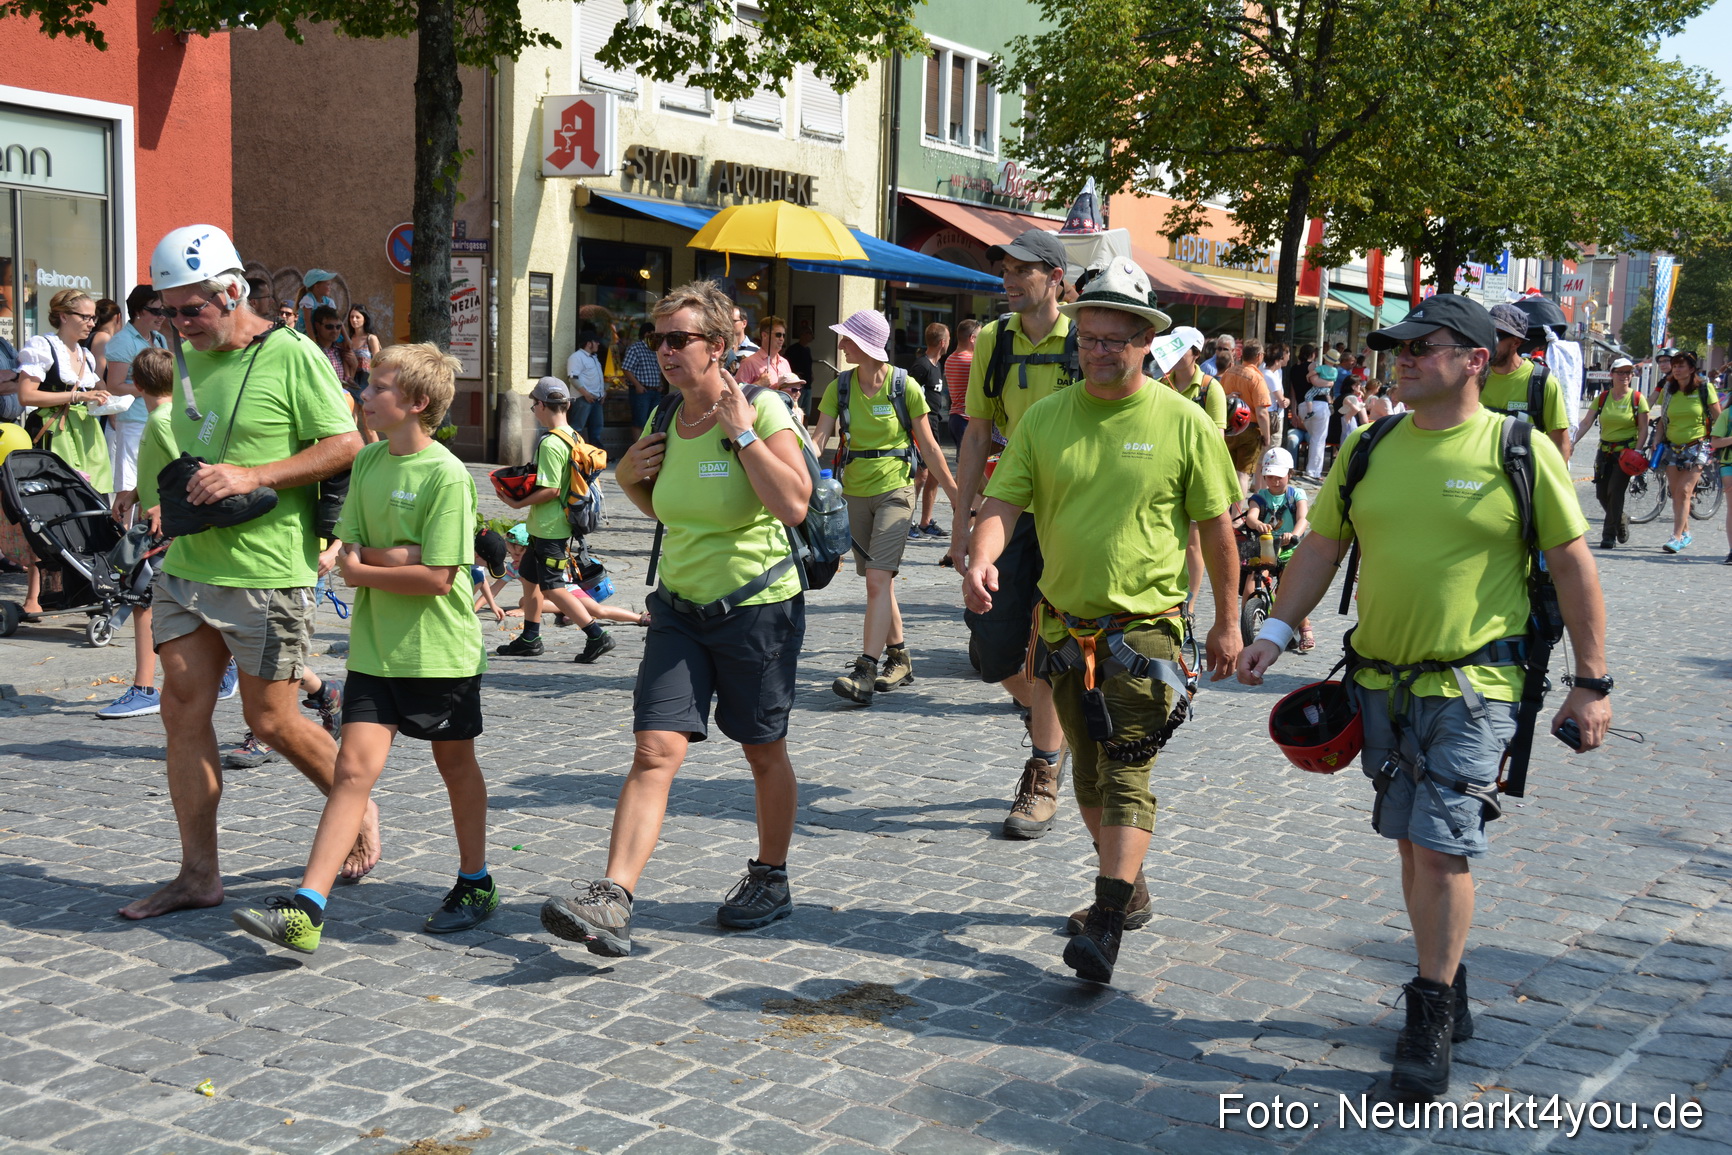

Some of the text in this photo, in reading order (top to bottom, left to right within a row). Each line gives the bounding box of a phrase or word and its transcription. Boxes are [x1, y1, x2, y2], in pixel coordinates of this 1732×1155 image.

[632, 145, 819, 206] STADT APOTHEKE
[951, 174, 993, 193] METZGEREI
[1175, 235, 1210, 264] LEDER
[1563, 279, 1584, 292] H&M
[203, 422, 214, 442] DAV
[1132, 442, 1154, 451] DAV
[707, 463, 727, 471] DAV
[1456, 479, 1483, 490] DAV
